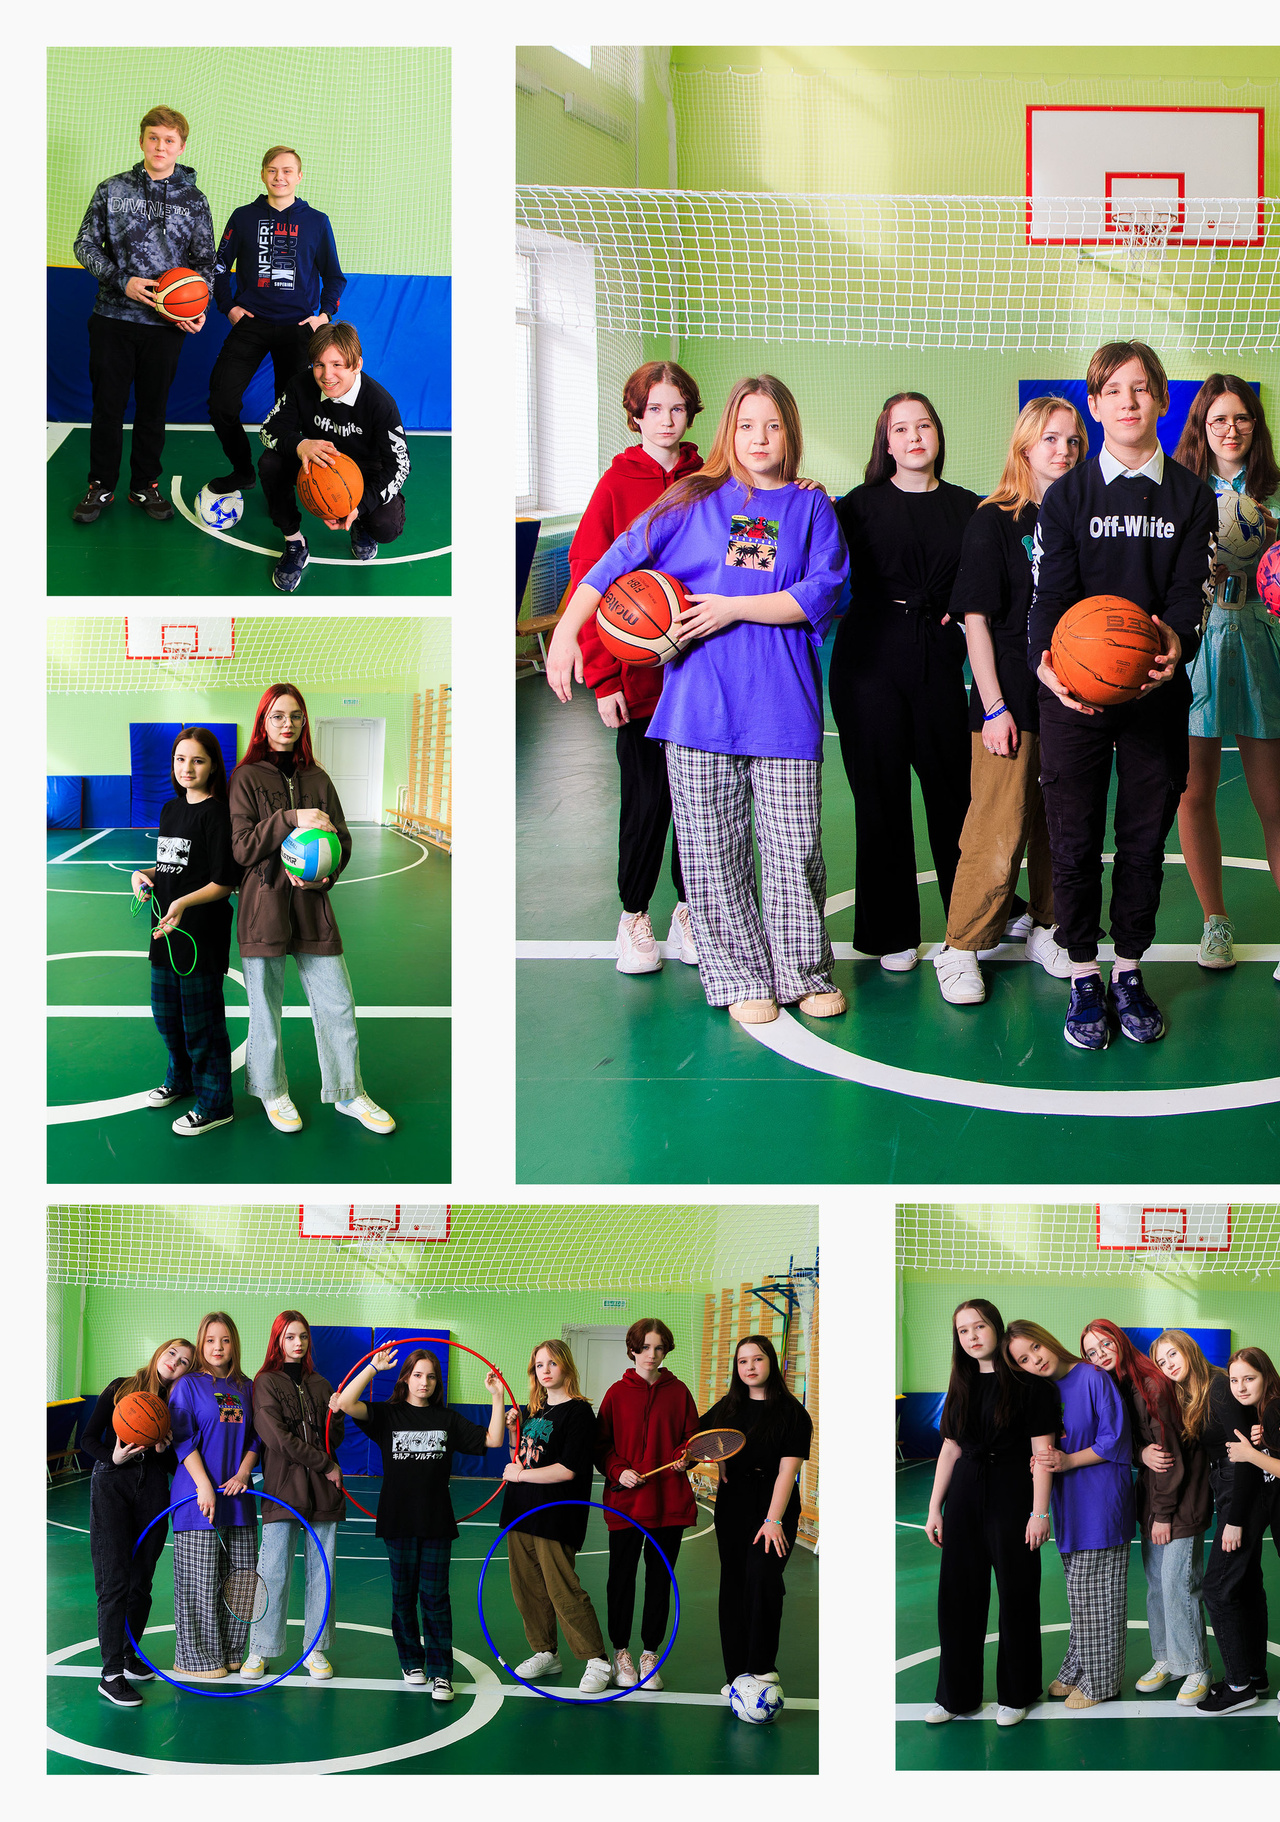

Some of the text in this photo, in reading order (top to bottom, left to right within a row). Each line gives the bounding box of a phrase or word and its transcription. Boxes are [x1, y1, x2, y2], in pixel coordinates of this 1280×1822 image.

[258, 225, 271, 275] NEVER
[313, 414, 363, 437] Off-White
[1089, 515, 1175, 539] Off-White
[627, 577, 645, 593] FIBA
